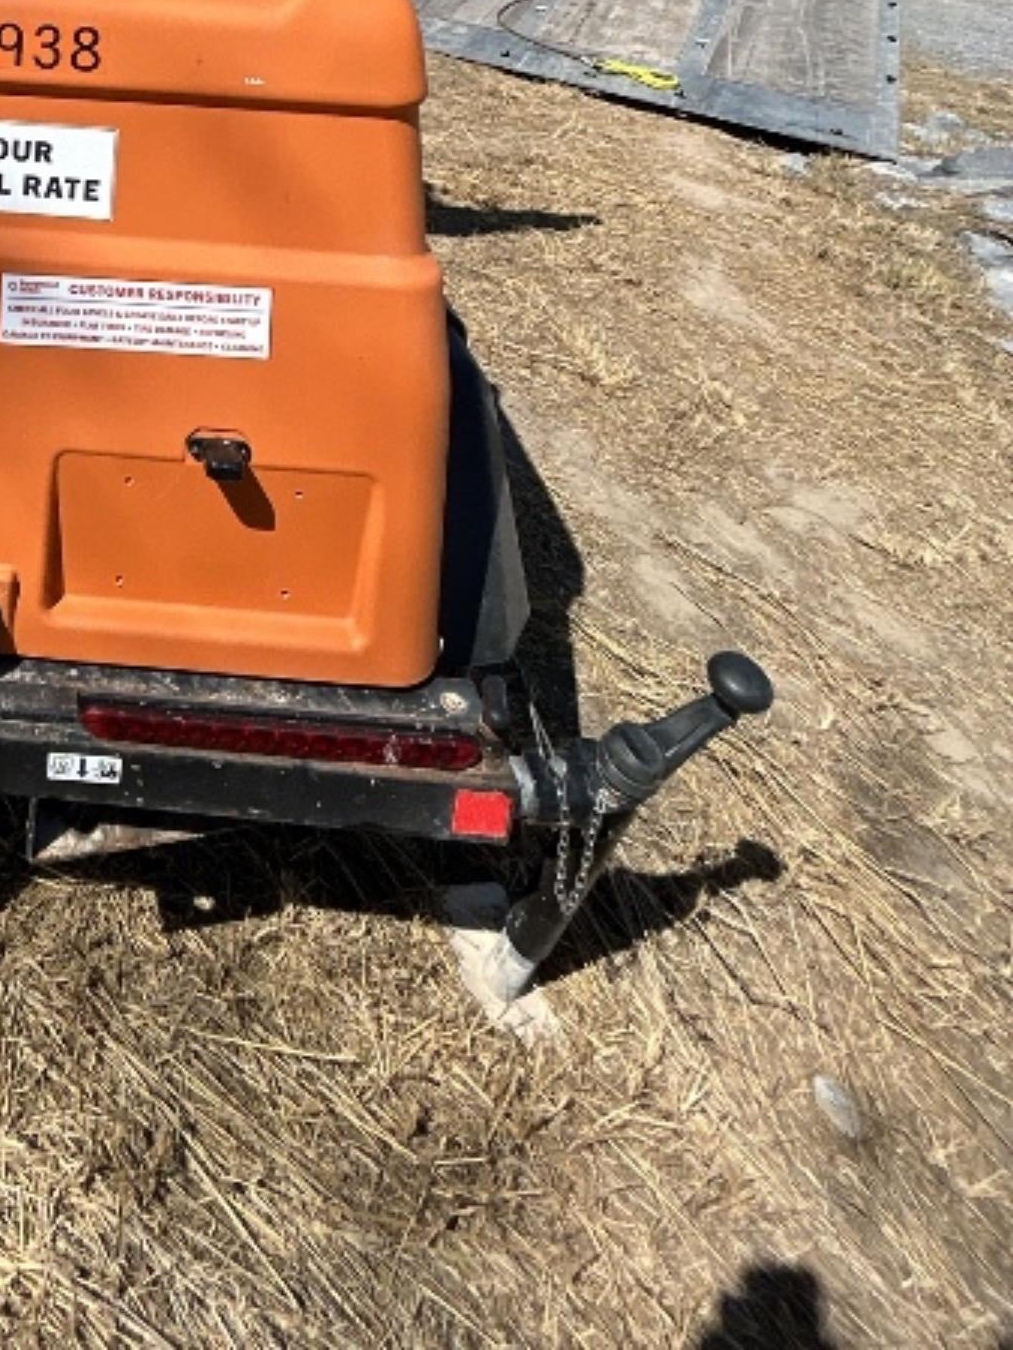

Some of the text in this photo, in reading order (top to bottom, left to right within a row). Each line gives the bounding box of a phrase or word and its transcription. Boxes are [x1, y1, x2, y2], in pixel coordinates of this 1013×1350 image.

[22, 174, 101, 202] RATE
[68, 283, 144, 300] CUSTOMER
[148, 286, 261, 307] RESPONSIBILITY
